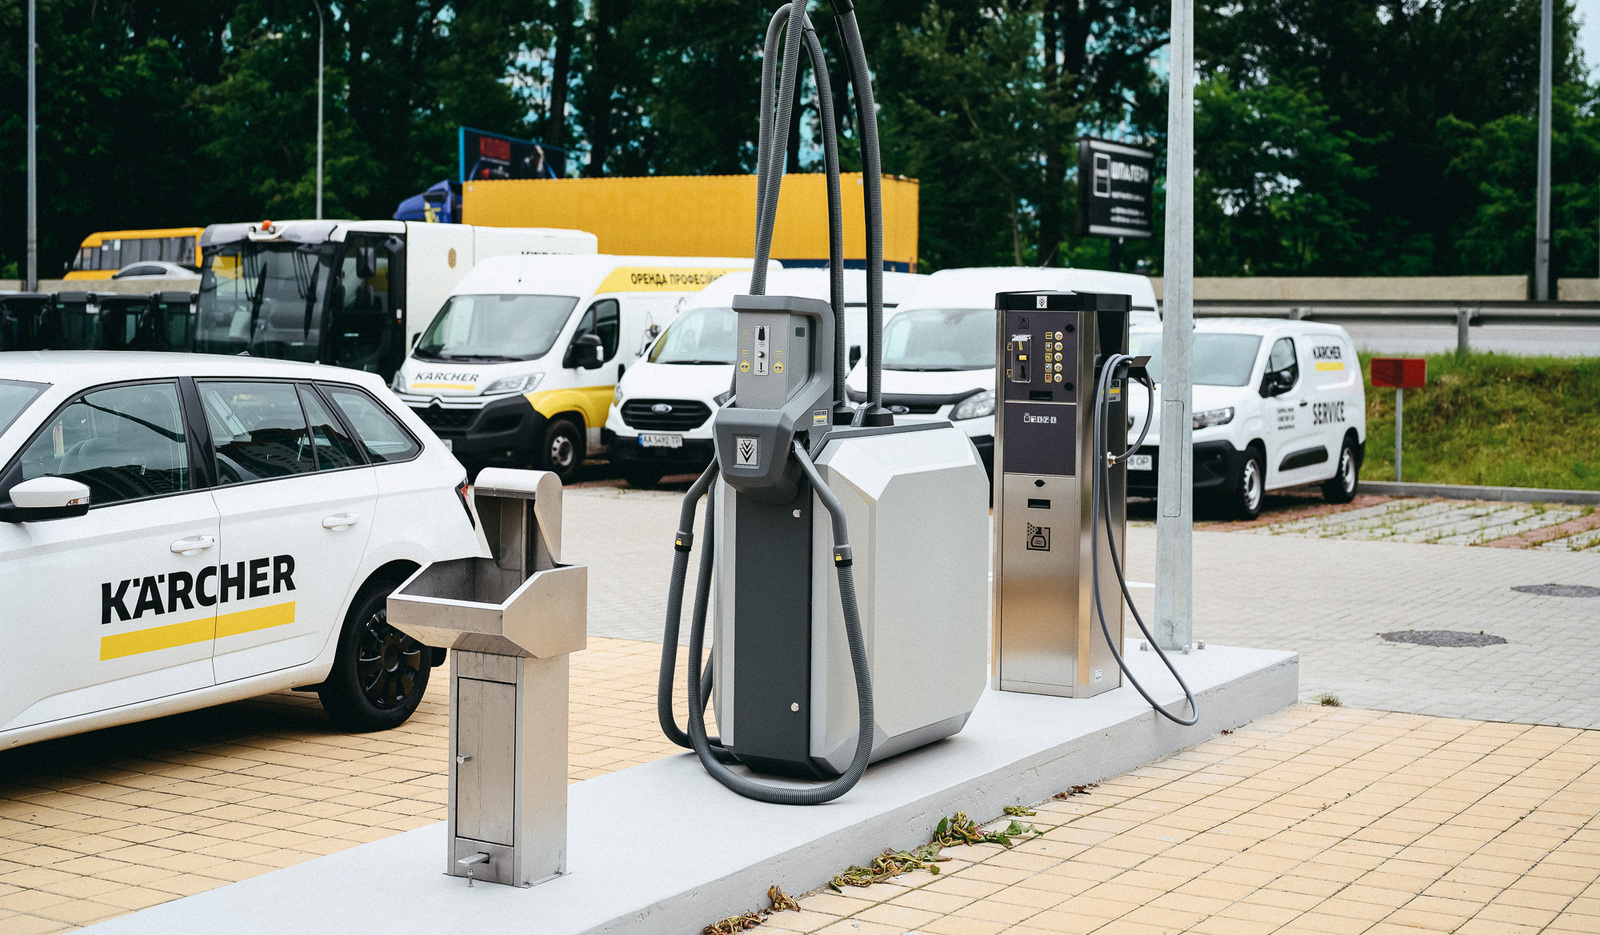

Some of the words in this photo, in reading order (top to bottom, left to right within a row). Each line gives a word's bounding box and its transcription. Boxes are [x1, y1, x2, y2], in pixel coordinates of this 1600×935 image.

[631, 273, 668, 286] ОРЕНДА
[1312, 401, 1345, 425] SERVICE
[101, 554, 297, 625] KÄRCHER
